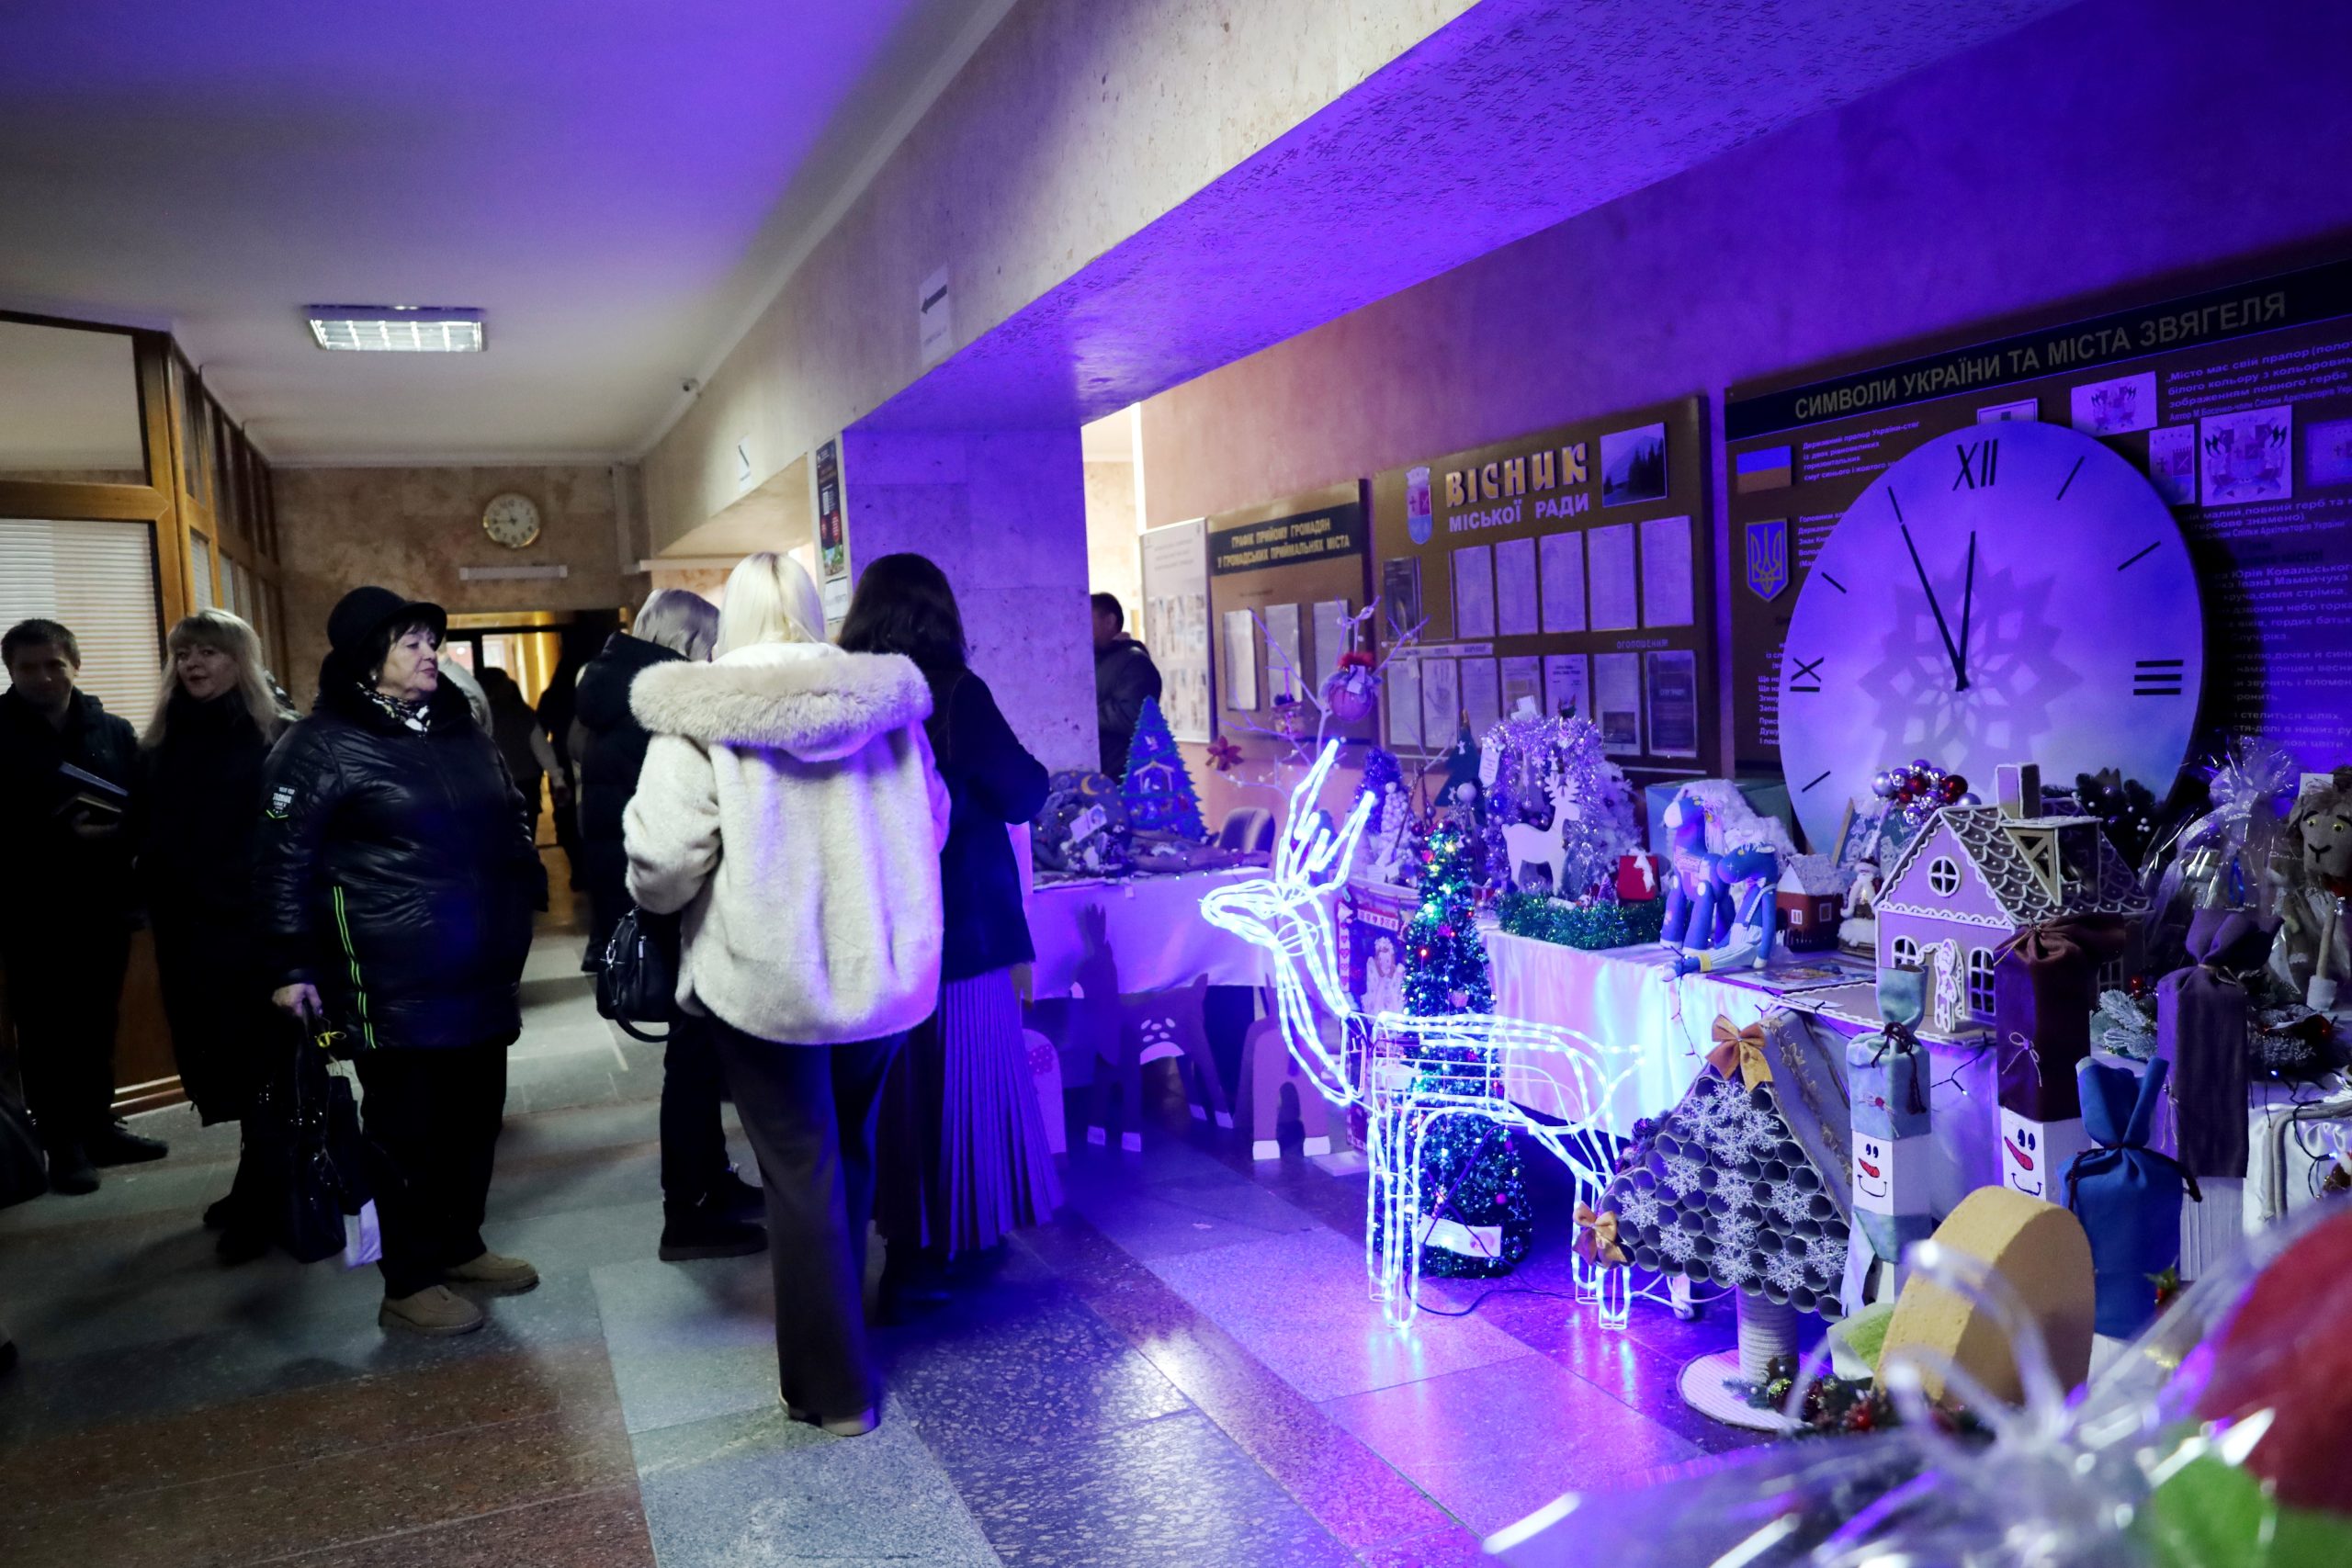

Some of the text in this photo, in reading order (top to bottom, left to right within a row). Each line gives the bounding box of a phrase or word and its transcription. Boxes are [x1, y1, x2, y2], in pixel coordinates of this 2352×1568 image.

[1794, 290, 2287, 420] СИМВОЛИ УКРАЇНИ ТА МІСТА ЗВЯГЕЛЯ
[2232, 357, 2259, 370] свій
[2262, 349, 2309, 366] прапор
[2167, 382, 2205, 397] білого
[2208, 372, 2259, 389] кольору
[2168, 370, 2348, 409] зображенням повного герба
[1844, 431, 1871, 443] прапор
[1804, 456, 1860, 471] горизонтальних
[1821, 468, 1850, 479] синього
[1952, 438, 1998, 491] XII
[1445, 443, 1588, 507] ВІСНИК
[1448, 492, 1589, 533] МІСЬКОЇ РАДИ
[2295, 498, 2327, 512] герб
[2329, 497, 2346, 507] та
[1256, 525, 1288, 545] ПРИЙОМУ
[1291, 517, 1332, 538] ГРОМАДЯН
[1223, 548, 1268, 567] ГРОМАДСЬКИХ
[1327, 534, 1351, 551] МІСТА
[2266, 564, 2352, 578] Ковальськог
[2274, 573, 2349, 588] Мамайчука
[2287, 603, 2317, 613] небо
[2270, 616, 2312, 627] гордих
[1789, 656, 1825, 693] IX
[2132, 659, 2184, 696] III
[2233, 693, 2282, 703] ронить.
[2231, 724, 2281, 734] стя-долі
